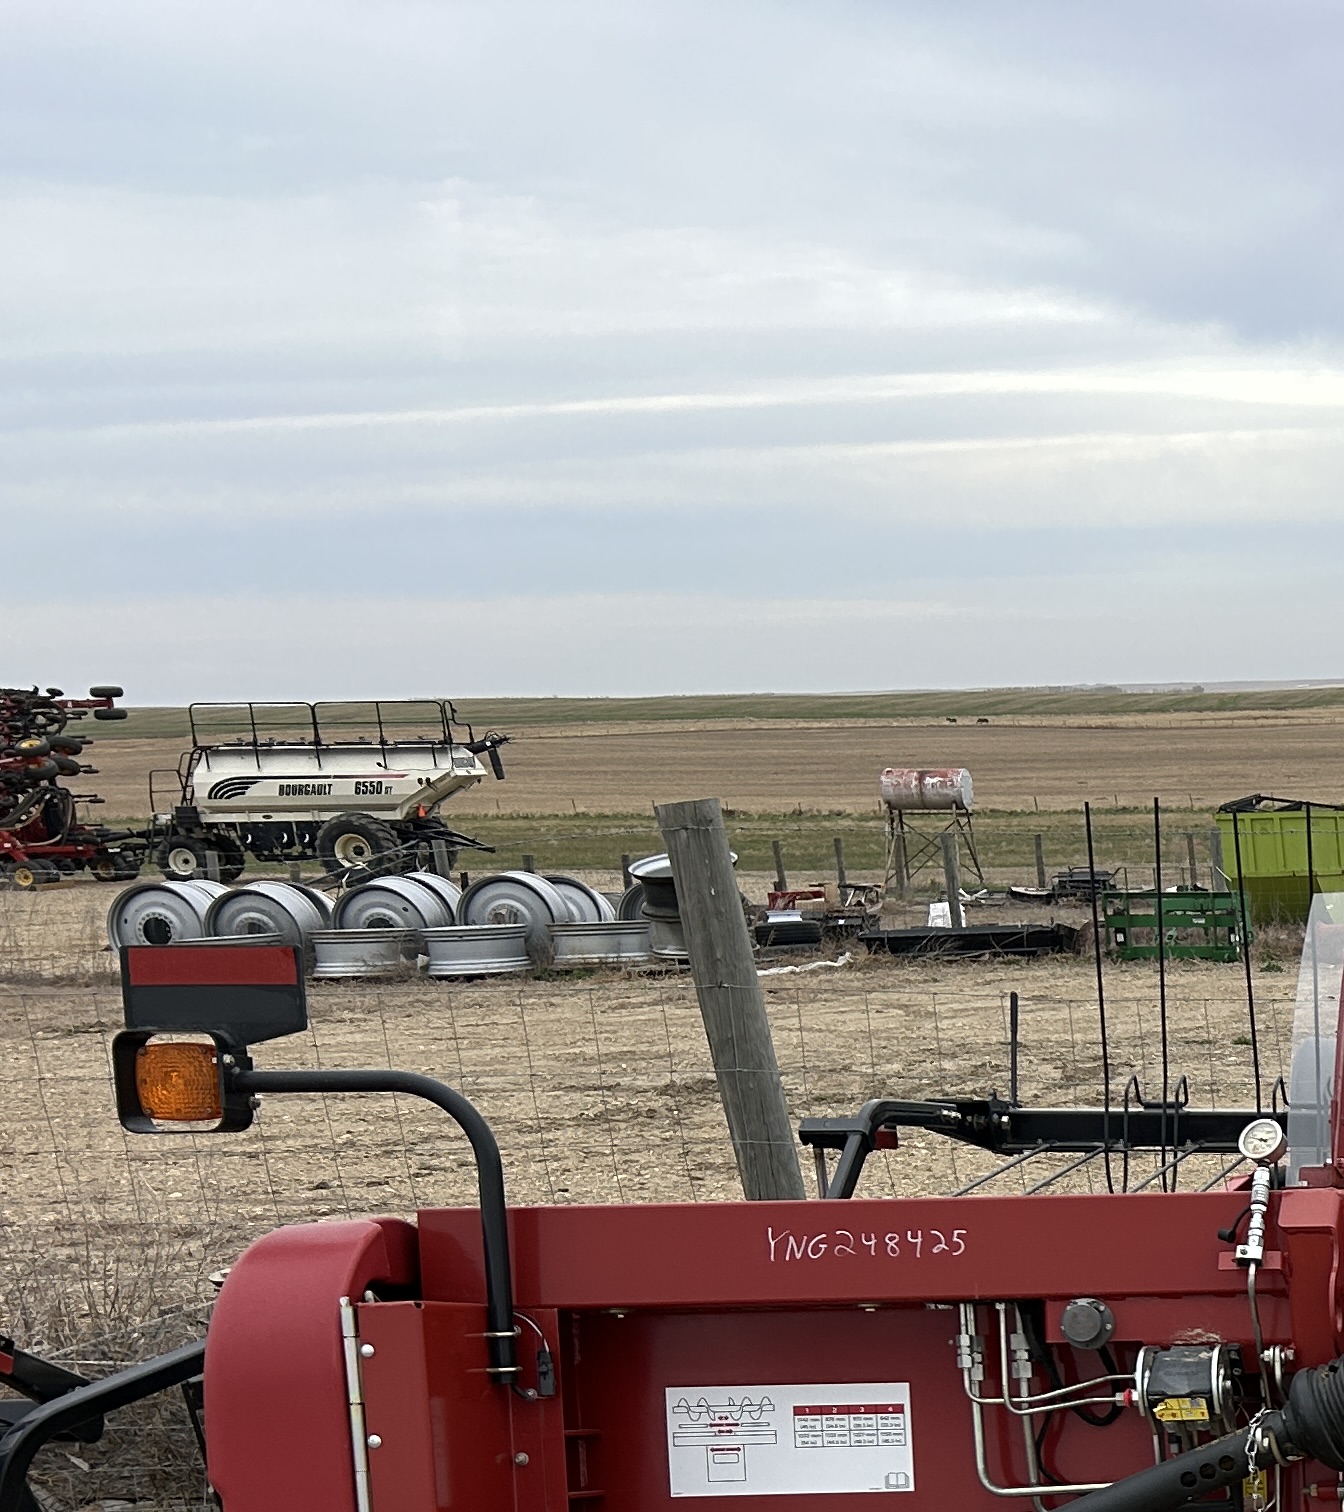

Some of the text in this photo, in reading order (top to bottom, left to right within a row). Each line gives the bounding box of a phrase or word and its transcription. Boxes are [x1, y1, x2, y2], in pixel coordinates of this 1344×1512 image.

[278, 783, 333, 796] BOURGAULT
[354, 780, 383, 795] 6550
[767, 1227, 967, 1261] YNG248425
